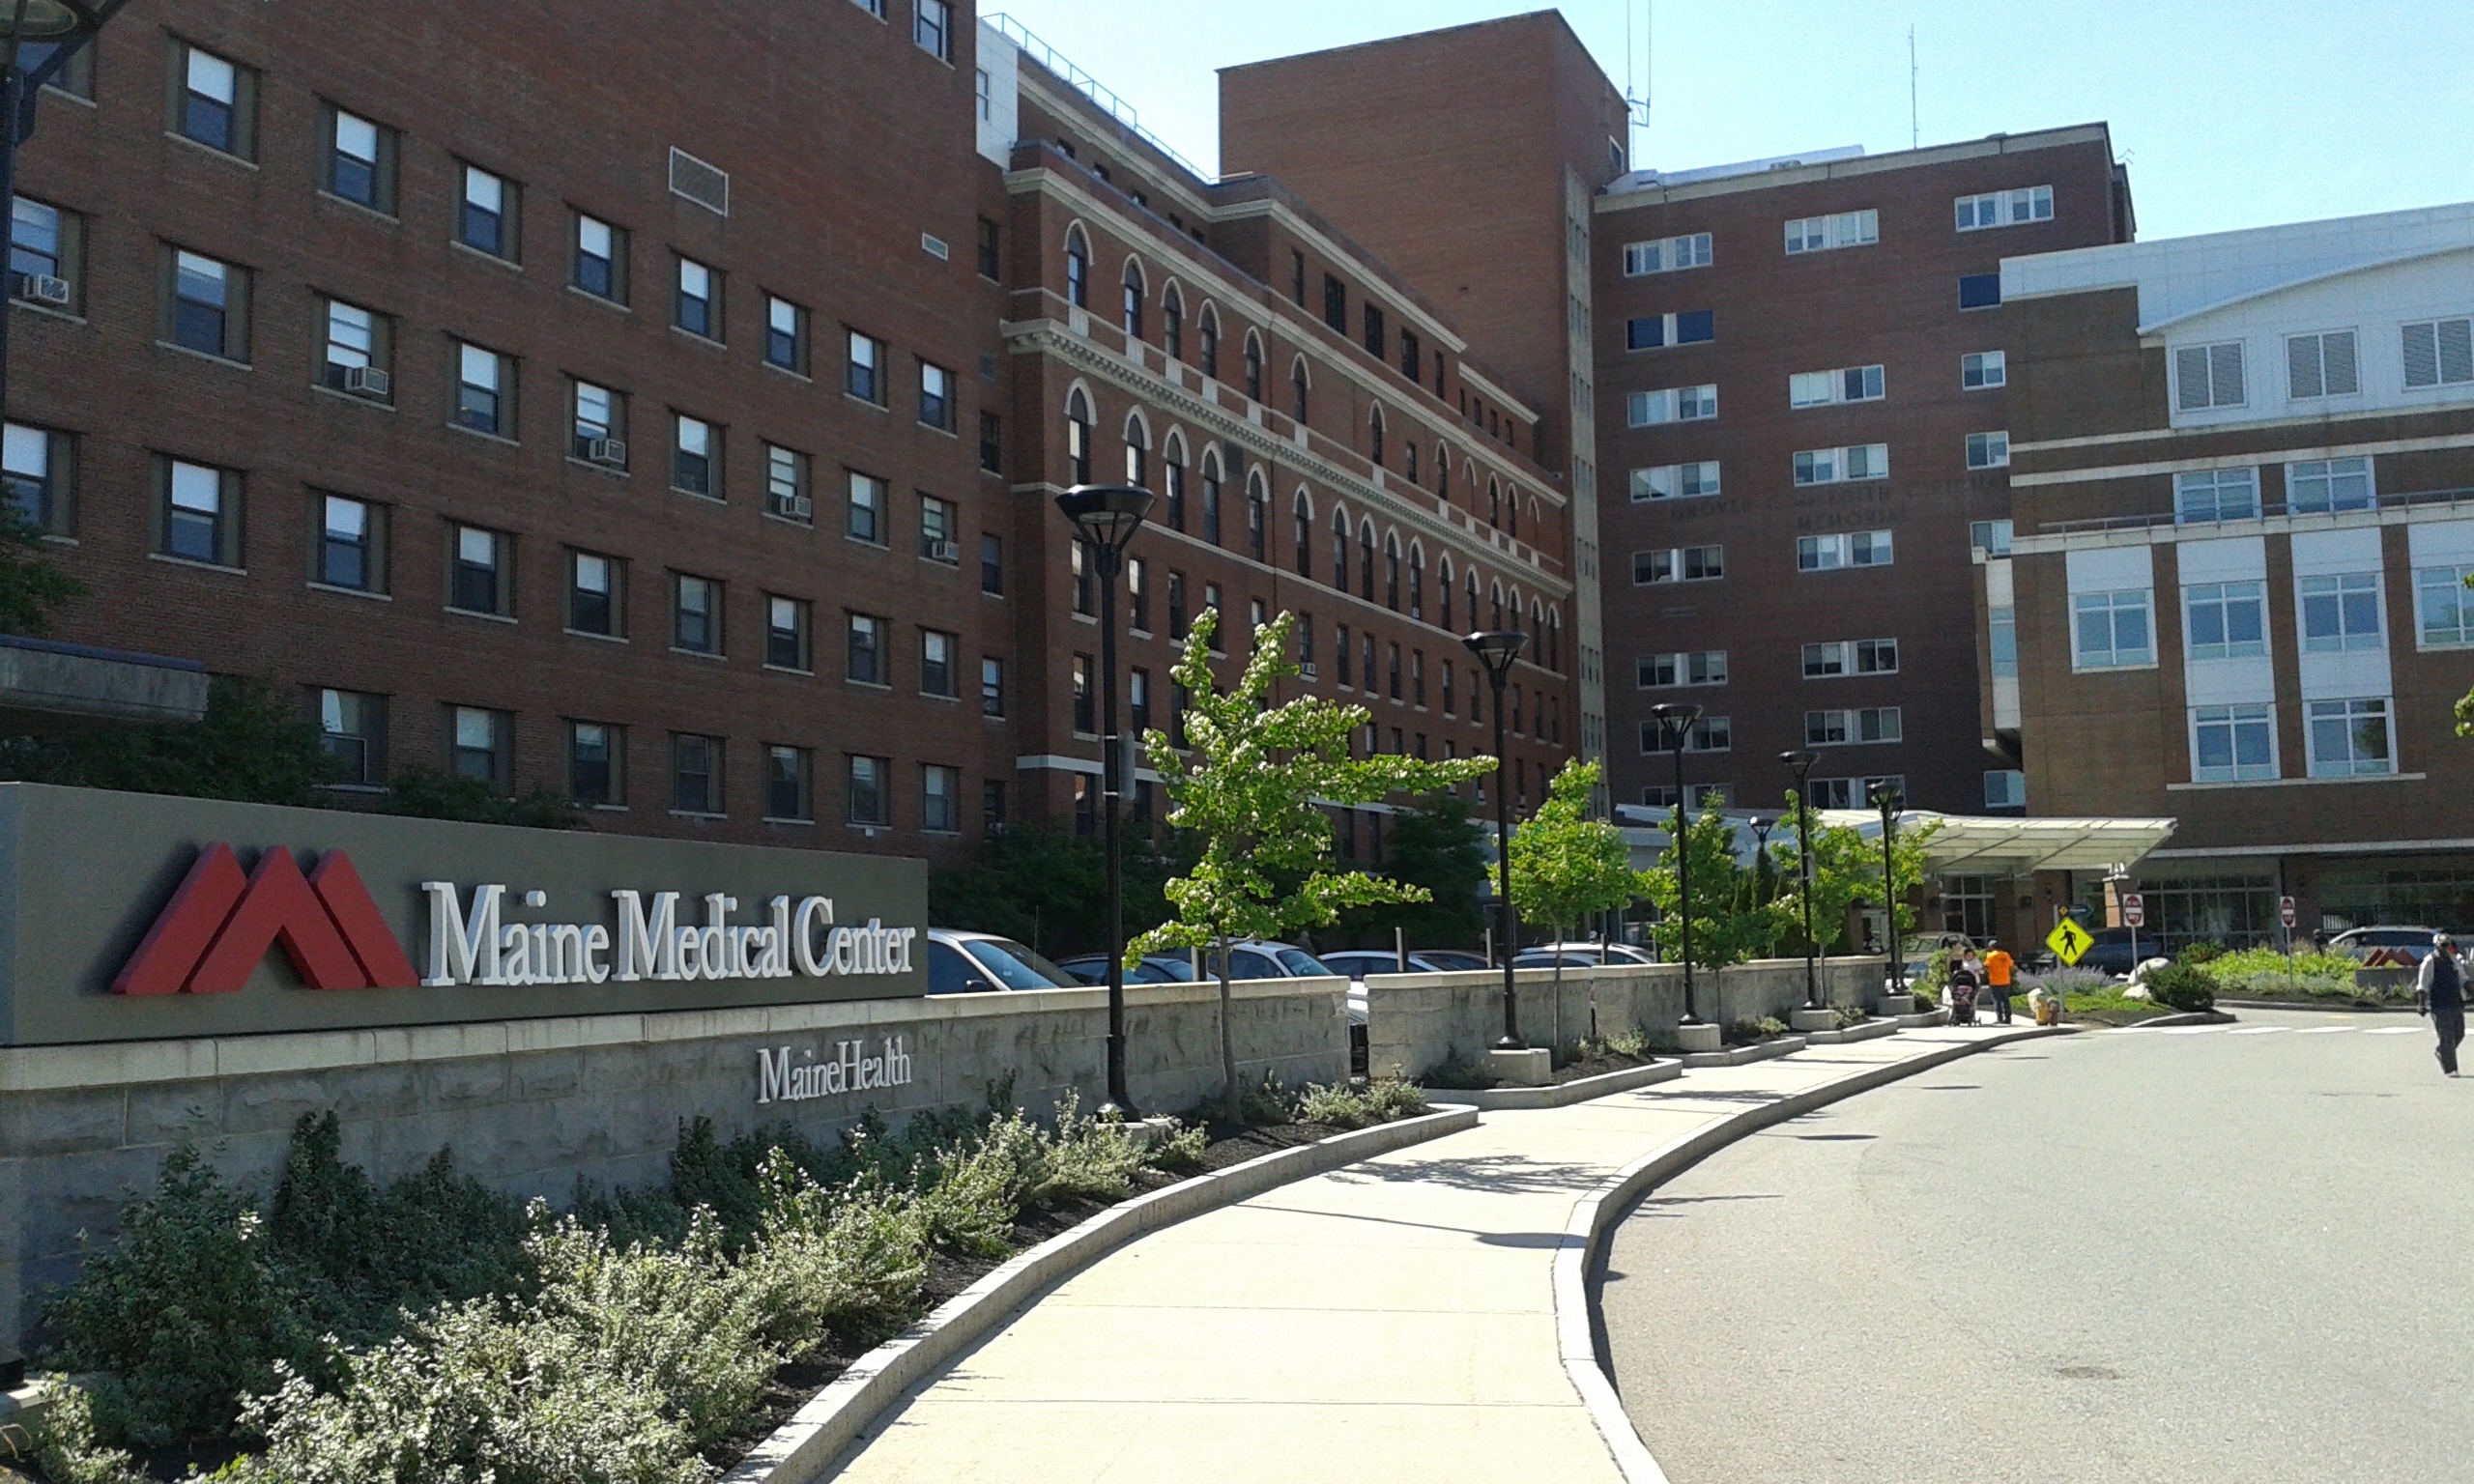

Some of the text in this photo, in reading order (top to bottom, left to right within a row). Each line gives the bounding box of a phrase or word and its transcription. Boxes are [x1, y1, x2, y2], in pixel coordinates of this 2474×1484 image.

[420, 882, 916, 986] Maine Medical Center
[757, 1035, 912, 1103] MaineHealth
